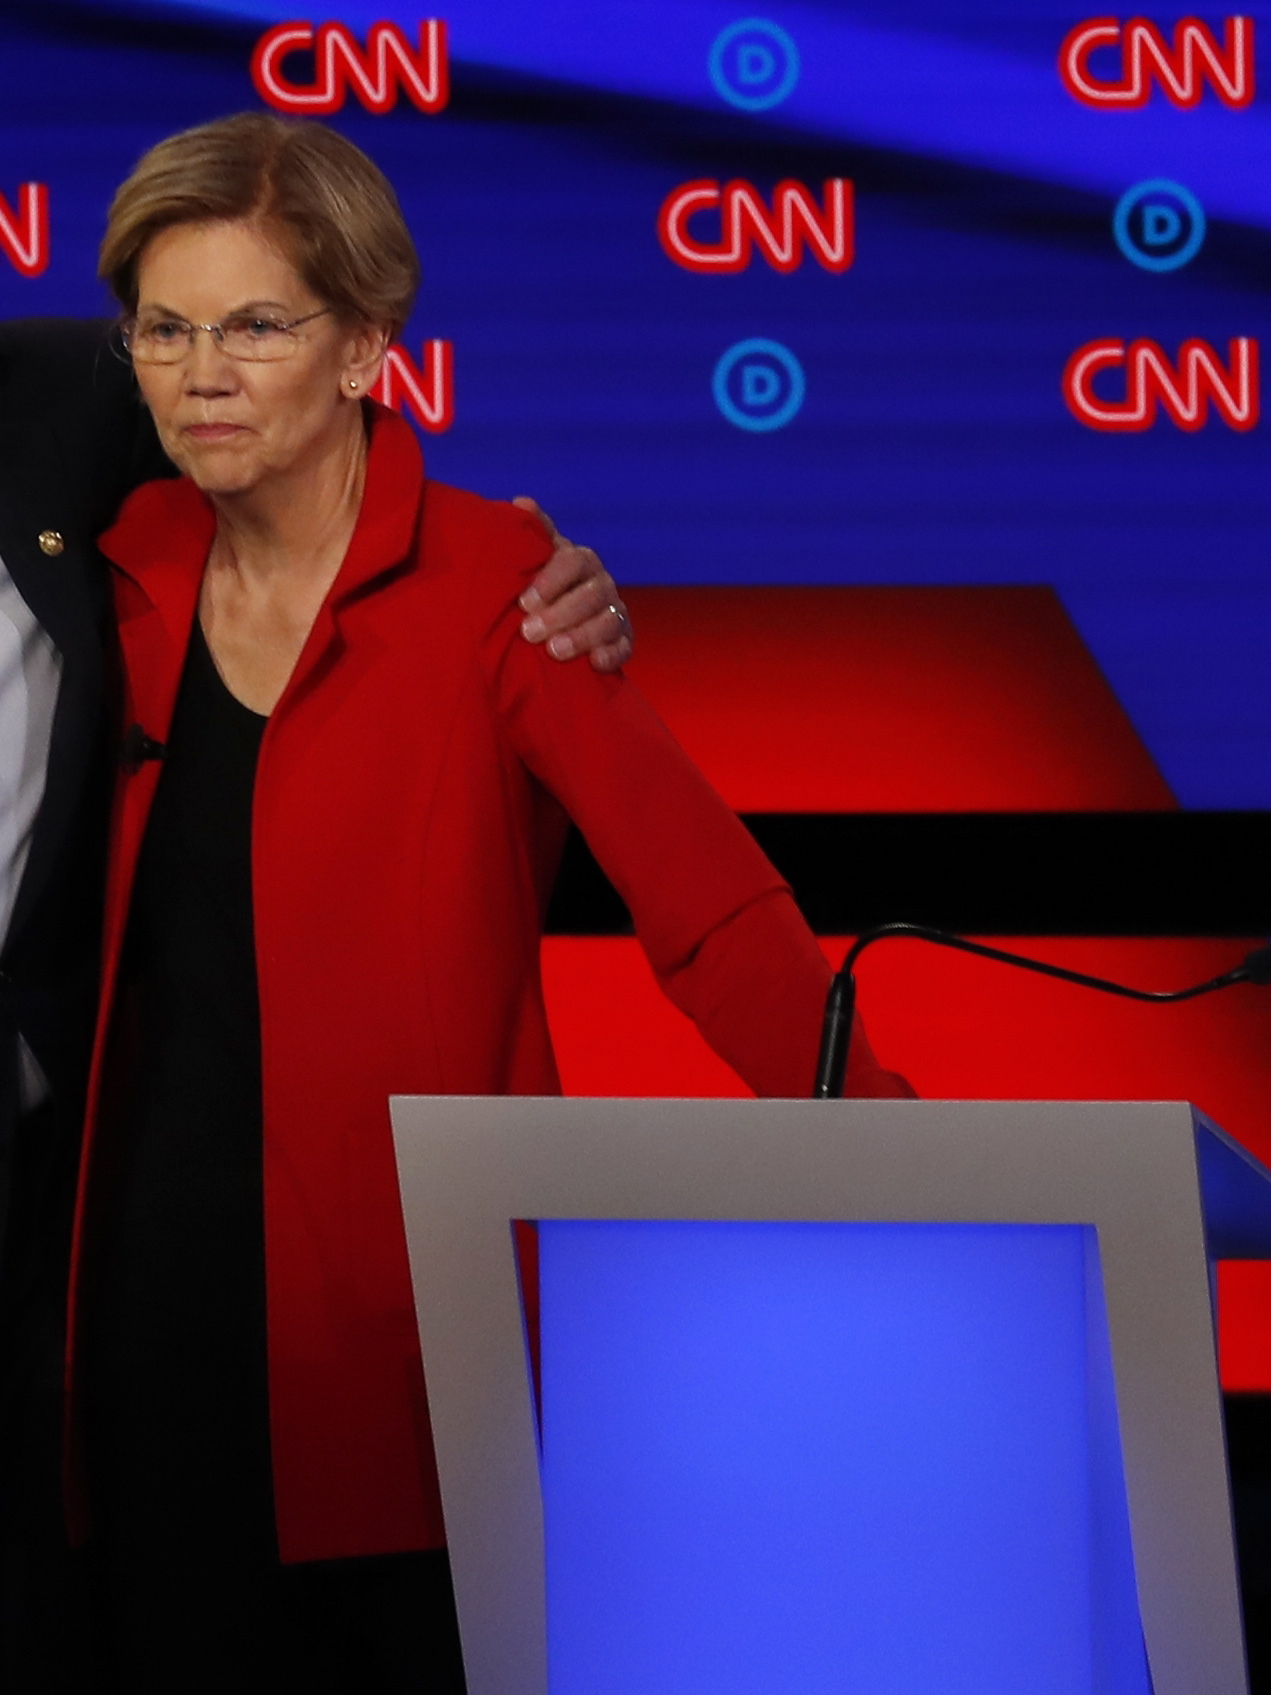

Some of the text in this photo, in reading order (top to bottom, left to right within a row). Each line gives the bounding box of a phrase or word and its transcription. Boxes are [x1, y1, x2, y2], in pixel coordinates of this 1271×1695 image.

[251, 17, 449, 113] CNN
[739, 47, 773, 83] D
[1057, 15, 1255, 112] CNN
[657, 178, 855, 274] CNN
[1143, 207, 1180, 245] D
[744, 366, 779, 404] D
[1062, 337, 1260, 433] CNN
